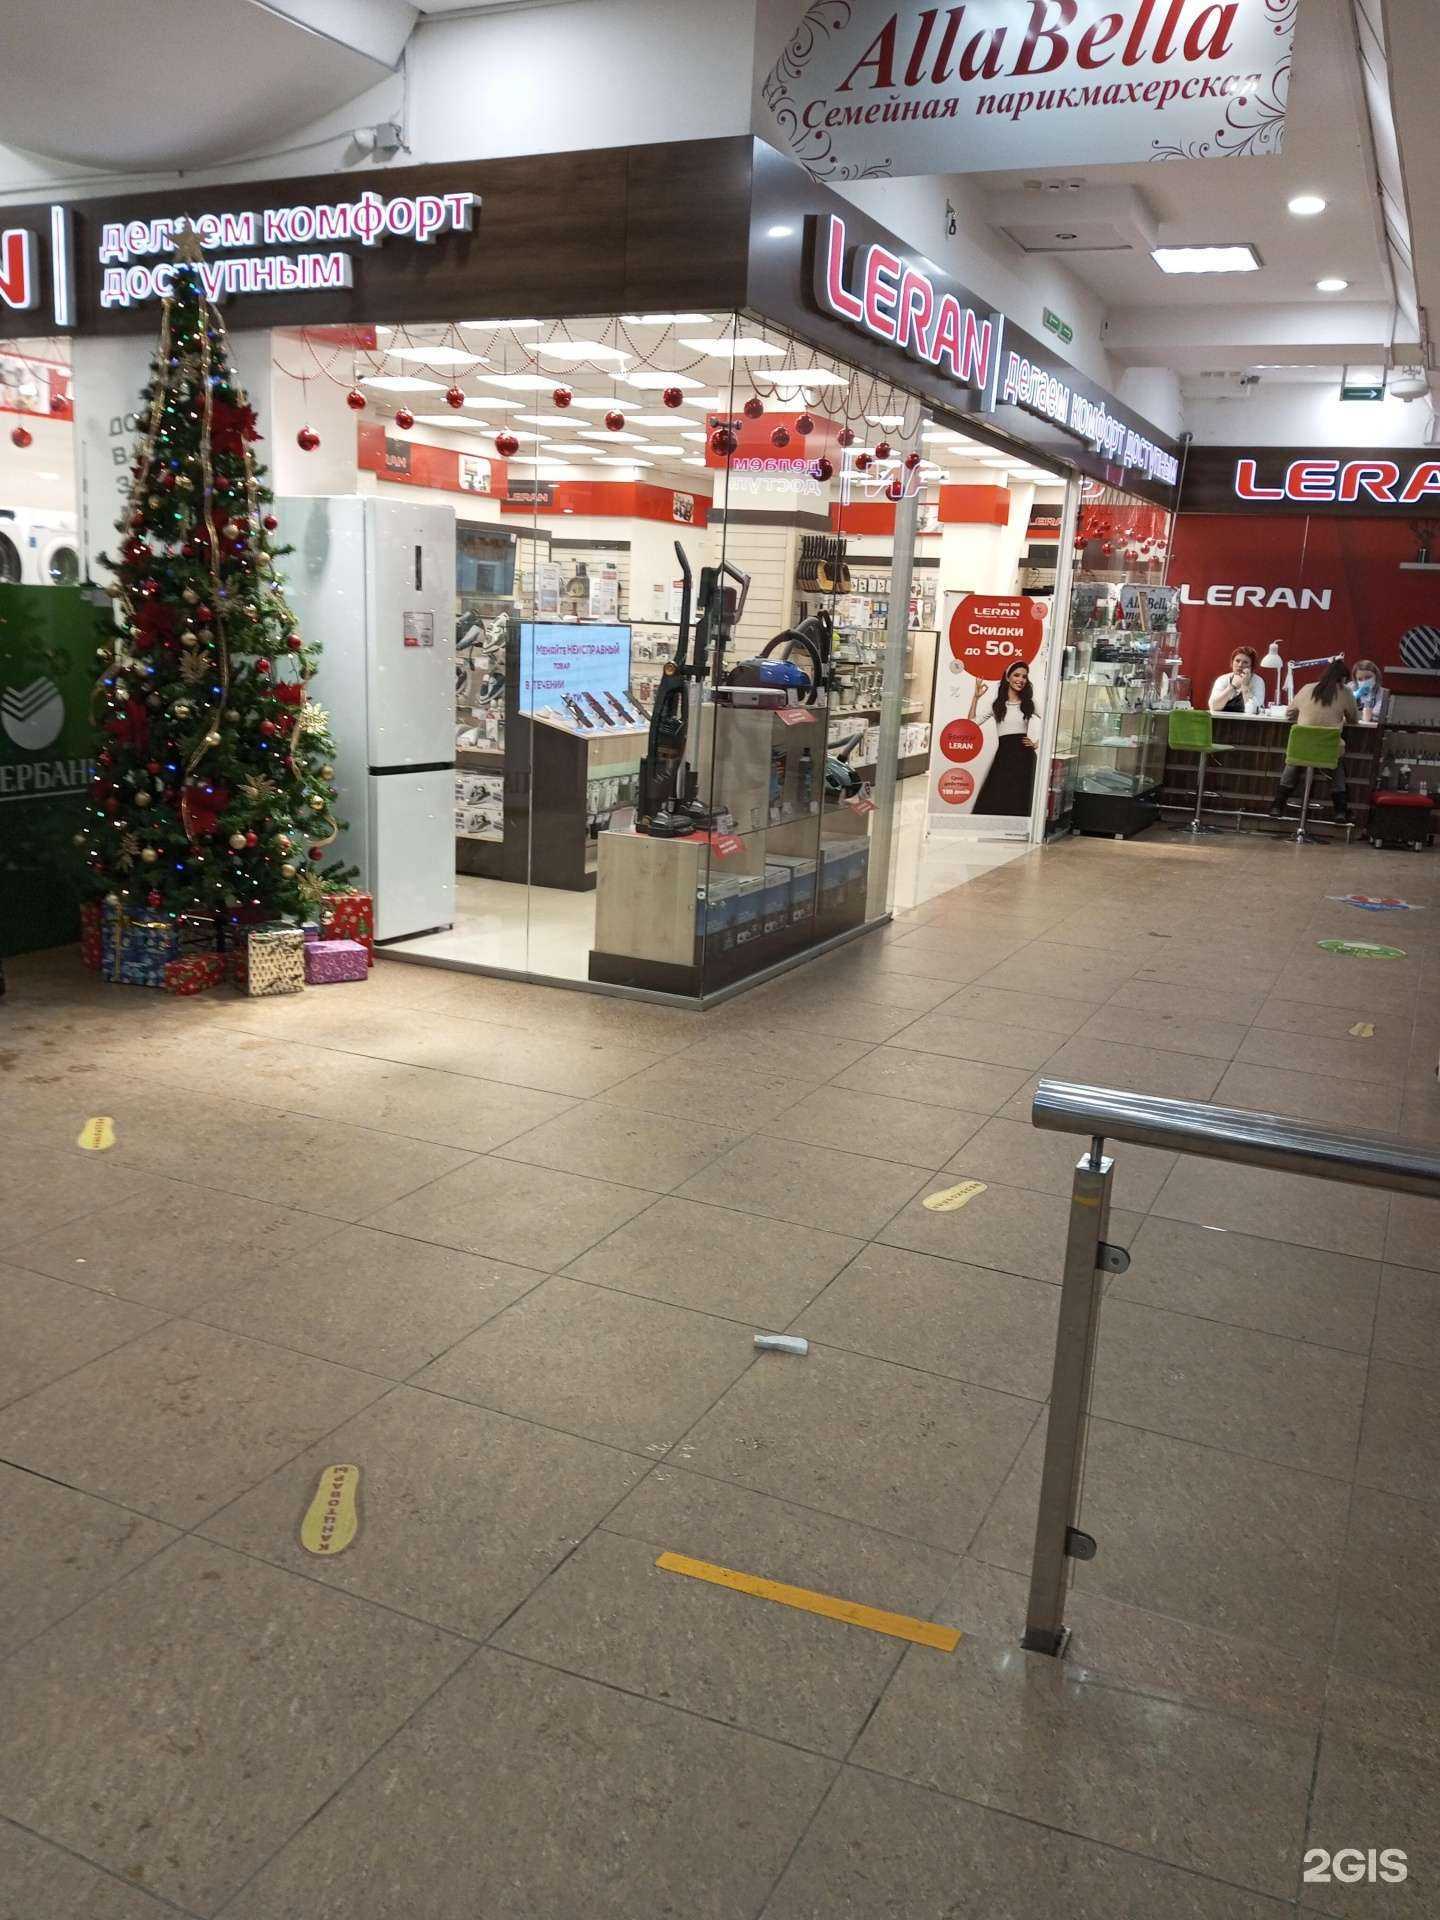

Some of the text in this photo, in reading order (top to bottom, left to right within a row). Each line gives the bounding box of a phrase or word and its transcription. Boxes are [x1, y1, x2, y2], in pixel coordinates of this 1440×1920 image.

[836, 0, 1239, 92] AllaBella
[803, 70, 1261, 129] Семейная парикмахерская
[263, 191, 474, 246] комфорт
[100, 252, 343, 308] досупным
[826, 213, 993, 391] LERAN
[1003, 350, 1070, 423] делаем
[1070, 392, 1127, 460] комфорт
[973, 607, 1020, 617] LERAN
[1179, 584, 1332, 611] LERAN
[968, 623, 1024, 637] Скидки
[985, 640, 1023, 657] 50%
[948, 742, 974, 750] LERAN
